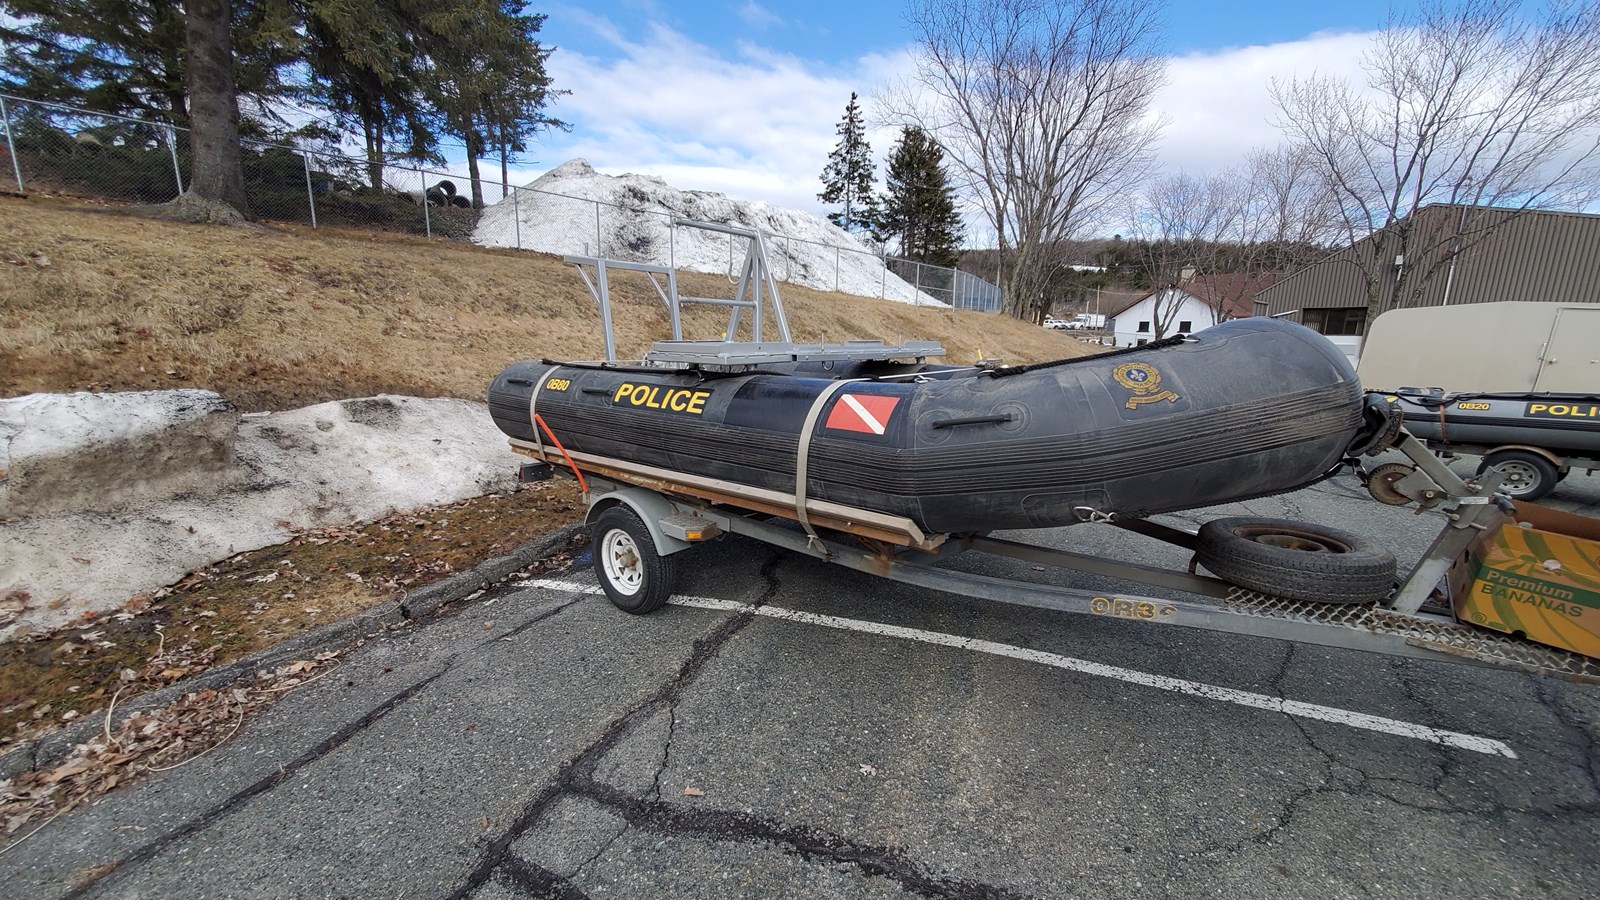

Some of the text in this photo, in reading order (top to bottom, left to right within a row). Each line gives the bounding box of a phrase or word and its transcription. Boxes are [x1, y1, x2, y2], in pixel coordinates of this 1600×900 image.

[614, 383, 711, 414] POLICE
[1529, 404, 1600, 417] POLI
[1480, 583, 1584, 617] BANANAS
[1486, 570, 1574, 600] Premium
